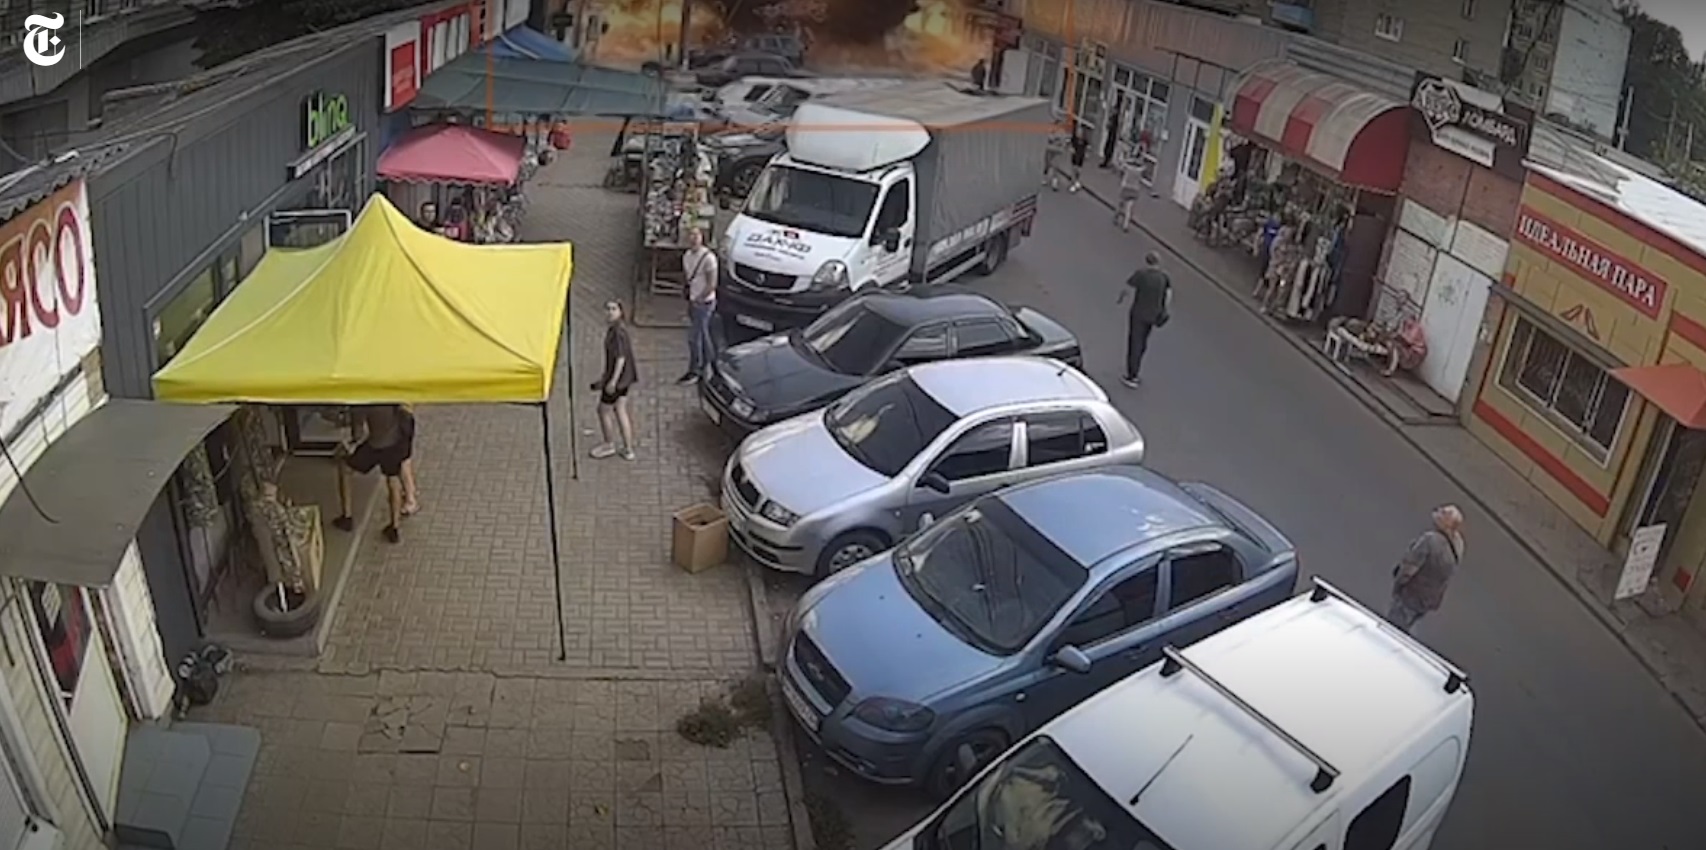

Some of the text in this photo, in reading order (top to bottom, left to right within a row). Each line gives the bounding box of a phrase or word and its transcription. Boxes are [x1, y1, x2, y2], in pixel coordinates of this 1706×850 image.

[0, 202, 84, 346] ЯСО
[1518, 215, 1657, 308] ИДЕАЛЬНАЯ ПАРА
